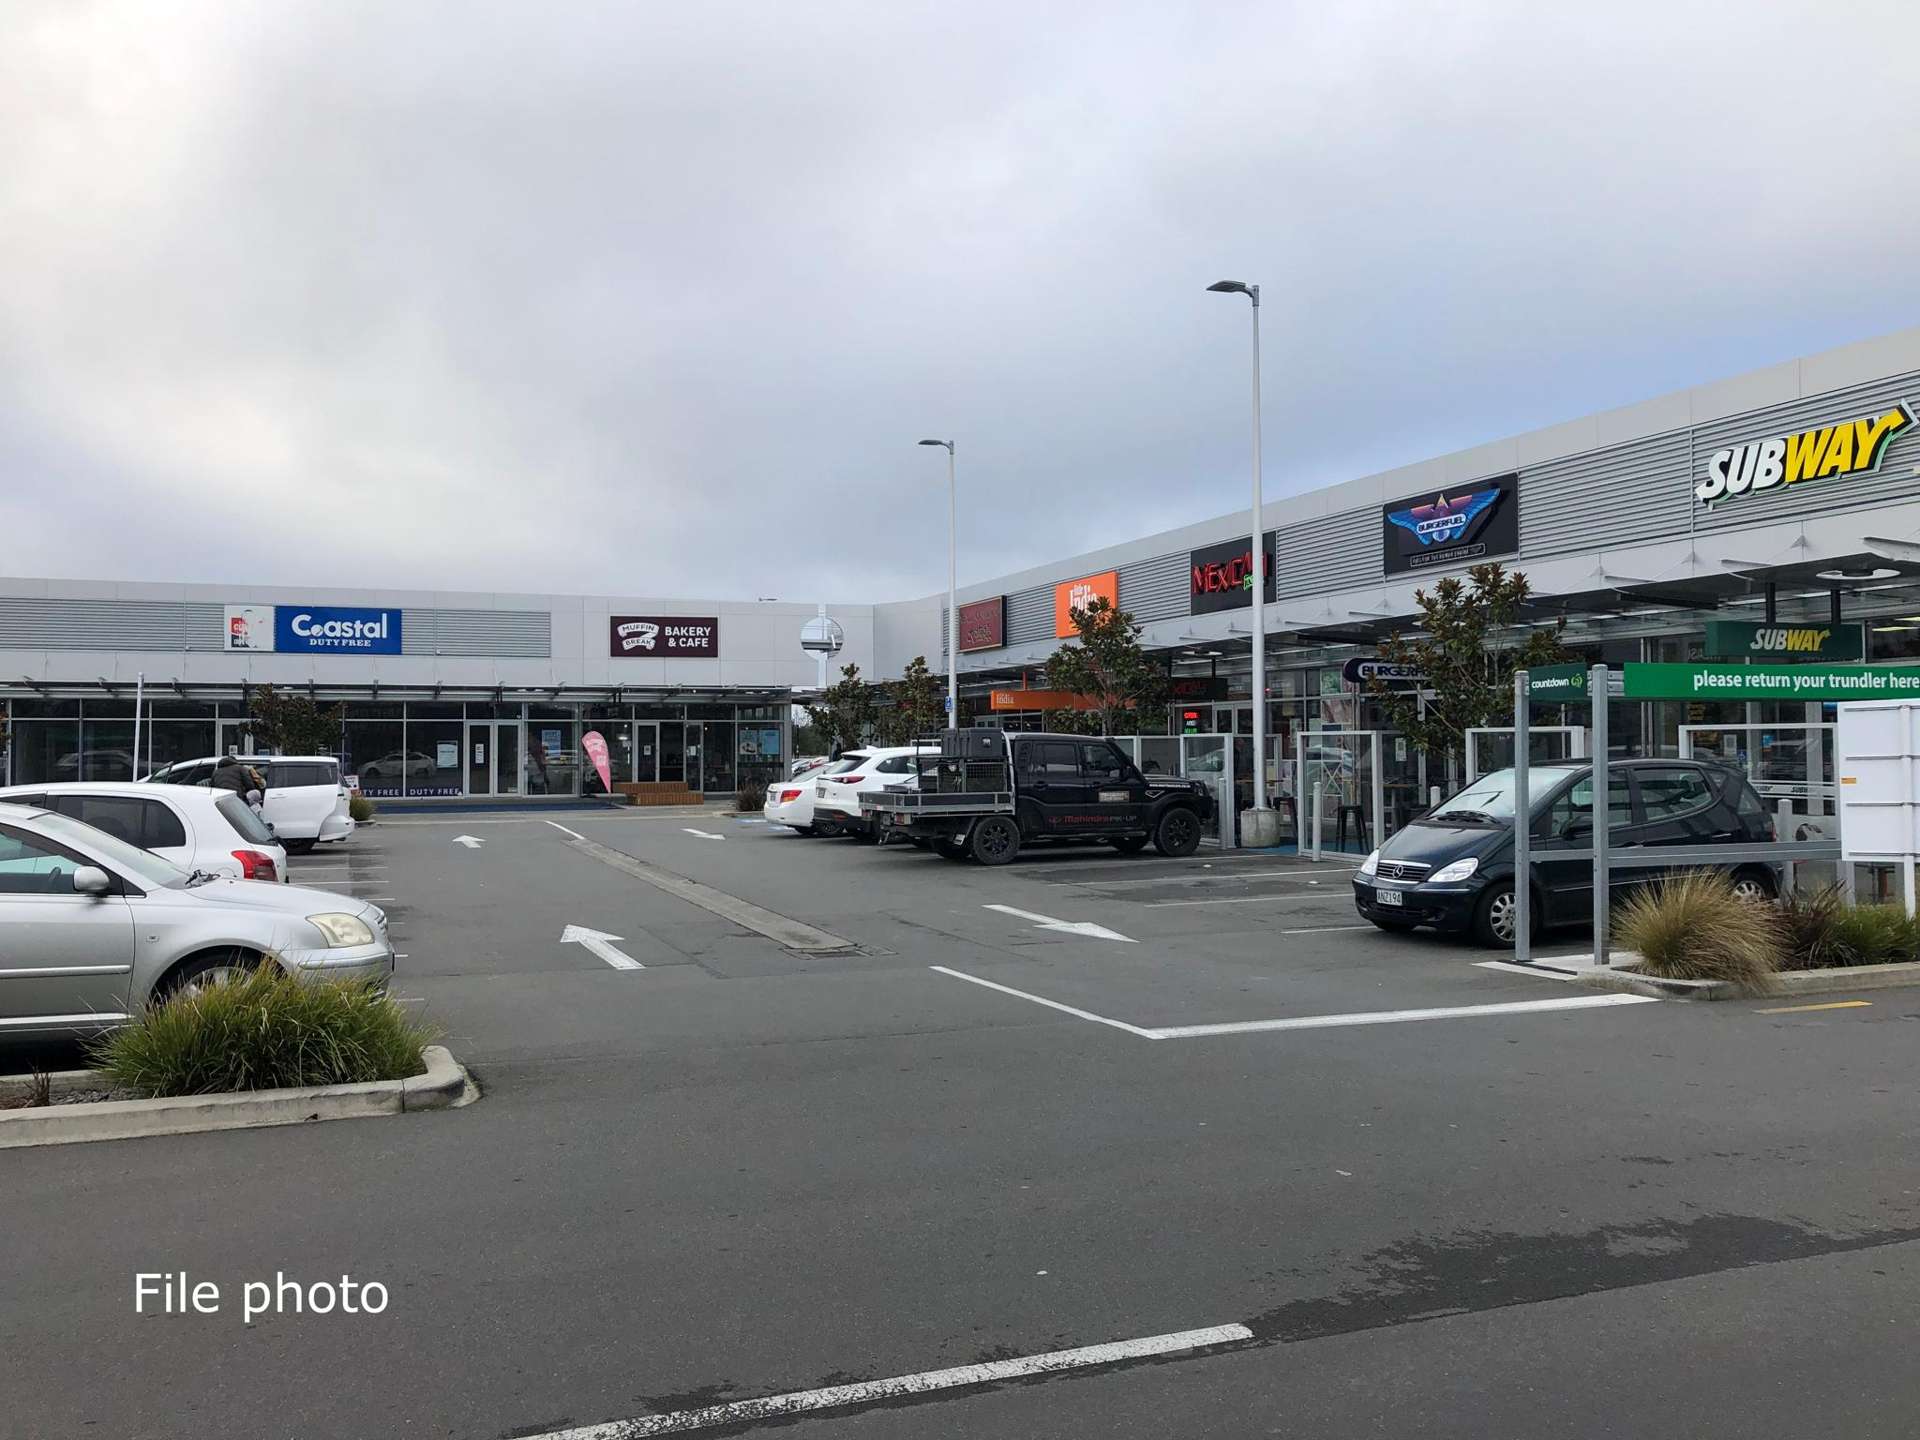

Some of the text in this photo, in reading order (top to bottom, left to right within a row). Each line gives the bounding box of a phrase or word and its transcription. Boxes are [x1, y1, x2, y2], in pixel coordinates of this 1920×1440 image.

[1695, 408, 1906, 500] SUBWAY
[1419, 515, 1464, 532] BURGERFUEL
[291, 612, 388, 639] Coastal
[622, 624, 655, 633] MUFFIN
[665, 626, 711, 636] BAKERY
[309, 638, 372, 647] DUTY FREE
[625, 638, 652, 646] BREAK
[668, 638, 709, 647] & CAFE
[1750, 628, 1831, 651] SUBWAY
[1531, 678, 1569, 689] countdown
[1693, 670, 1920, 692] please return your trundler here
[377, 788, 400, 796] FREE
[409, 788, 434, 796] DUTY
[437, 787, 460, 796] FREE
